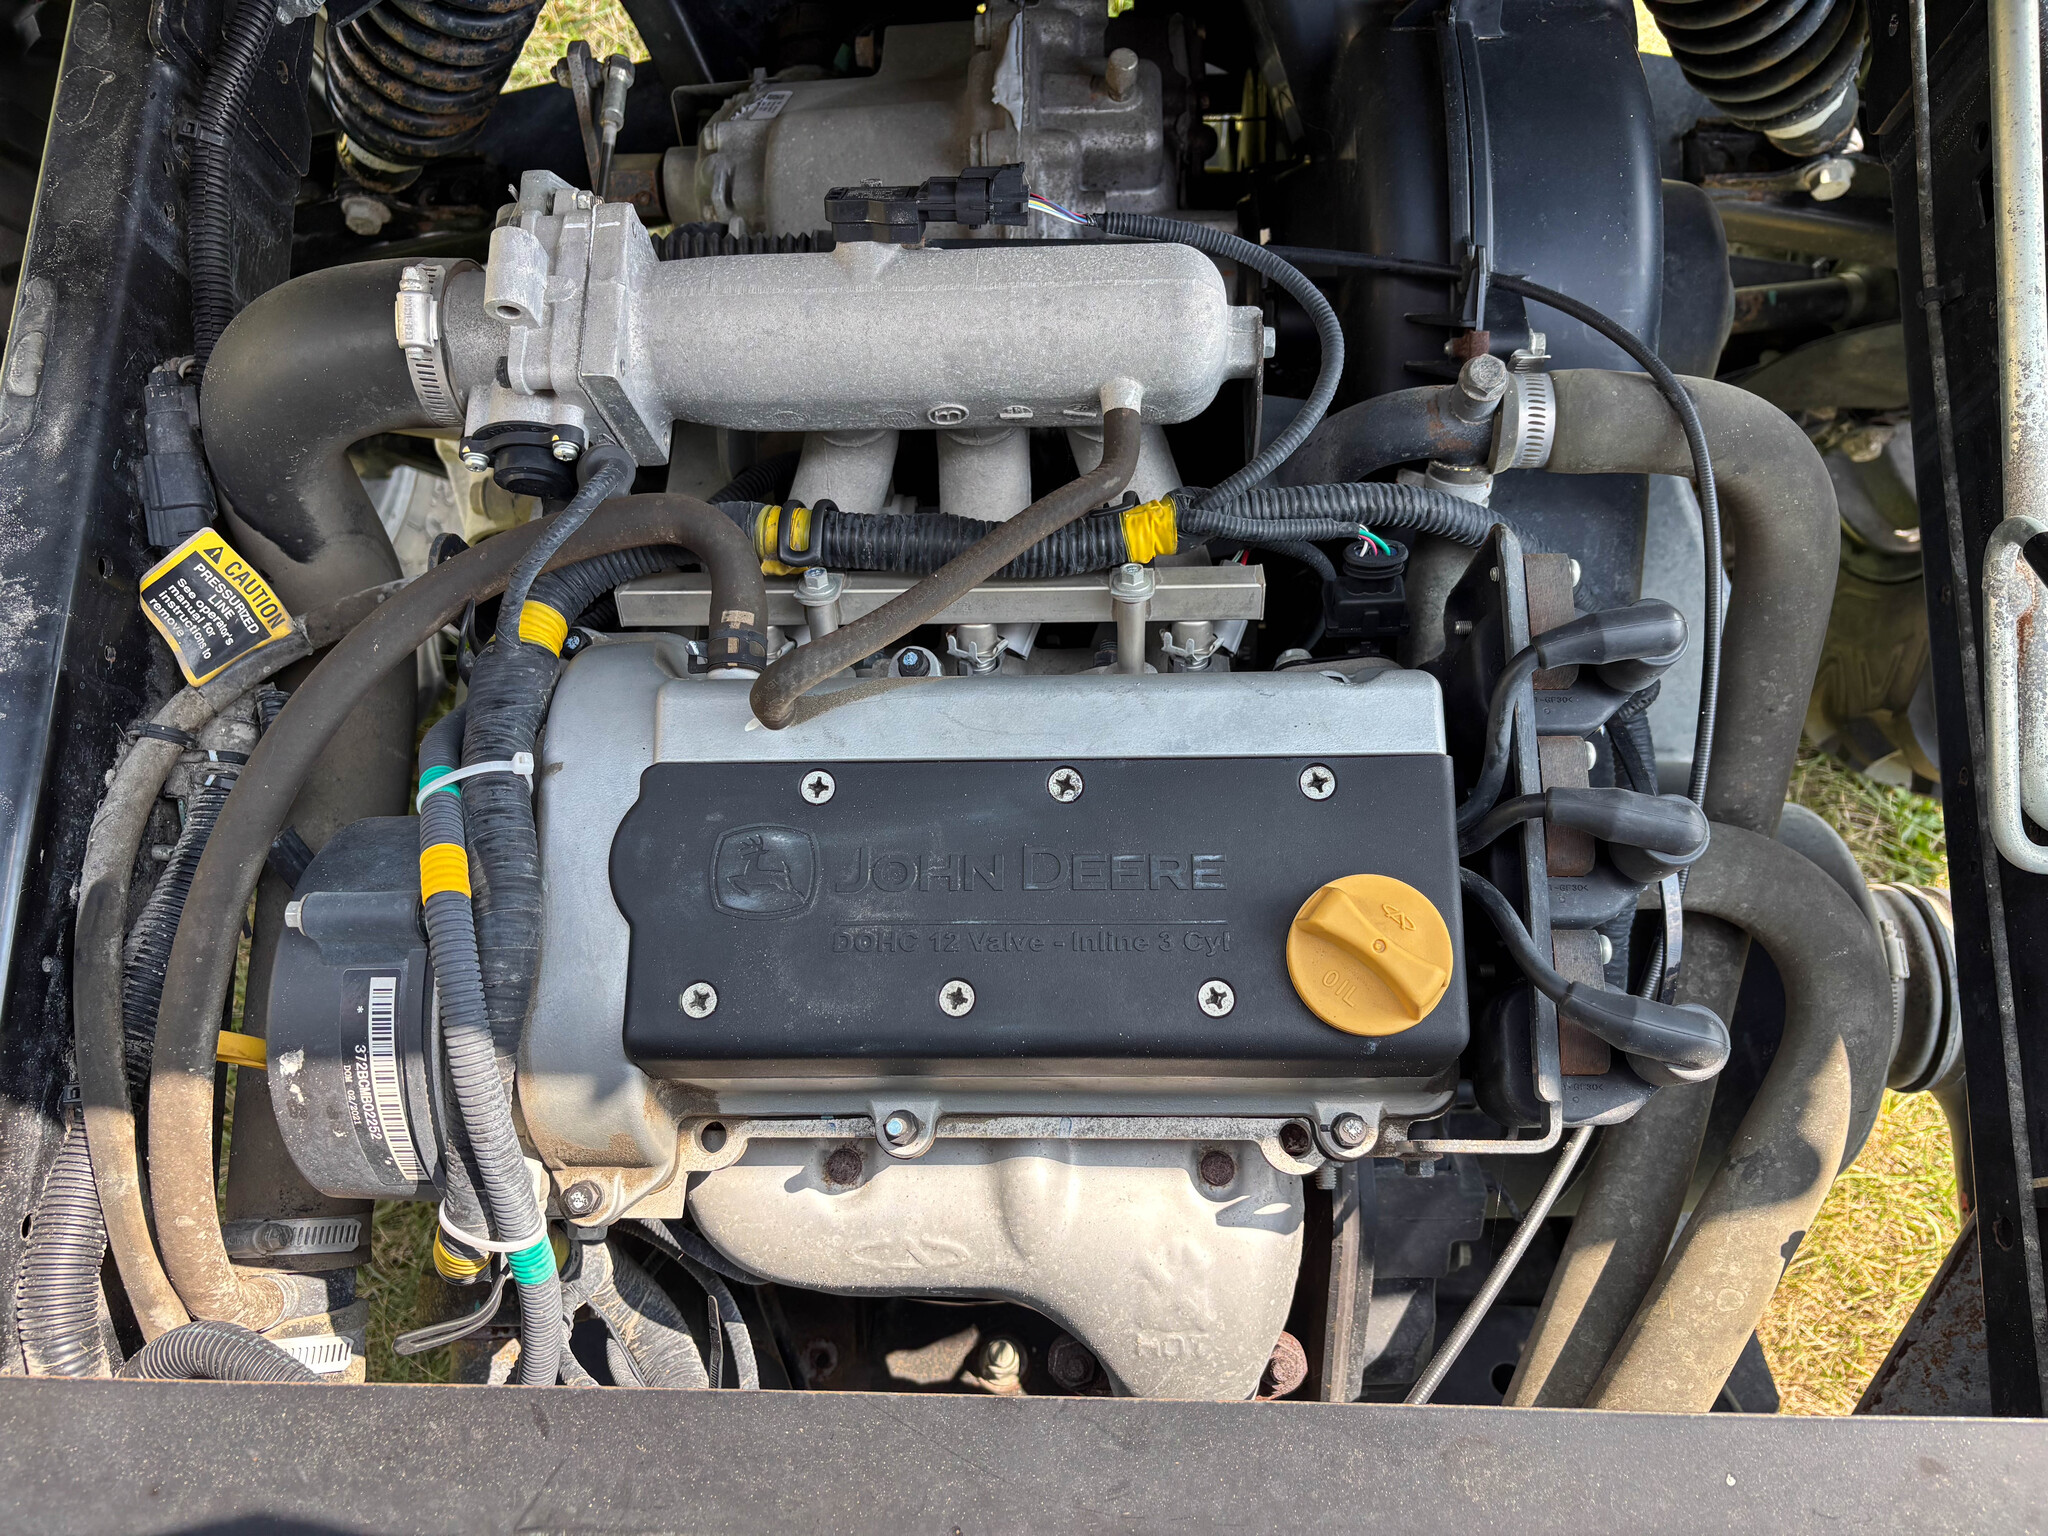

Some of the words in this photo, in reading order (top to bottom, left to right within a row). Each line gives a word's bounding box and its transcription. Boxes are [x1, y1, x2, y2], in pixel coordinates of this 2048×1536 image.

[168, 584, 206, 624] manual
[202, 621, 216, 638] for
[177, 577, 197, 600] See
[195, 599, 234, 646] operator's
[193, 562, 260, 634] PRESSURIZED
[207, 594, 236, 621] LINE
[224, 561, 286, 630] CAUTION
[158, 589, 207, 653] instructions
[202, 647, 212, 660] to
[834, 846, 1006, 895] JOHN
[1022, 845, 1228, 891] DEERE
[832, 930, 919, 954] DOHC
[928, 930, 961, 953] 12
[967, 930, 1045, 953] Valve
[1071, 930, 1150, 953] Inline
[1157, 930, 1174, 953] 3
[1182, 930, 1232, 958] Cyl
[1322, 970, 1357, 1008] OIL
